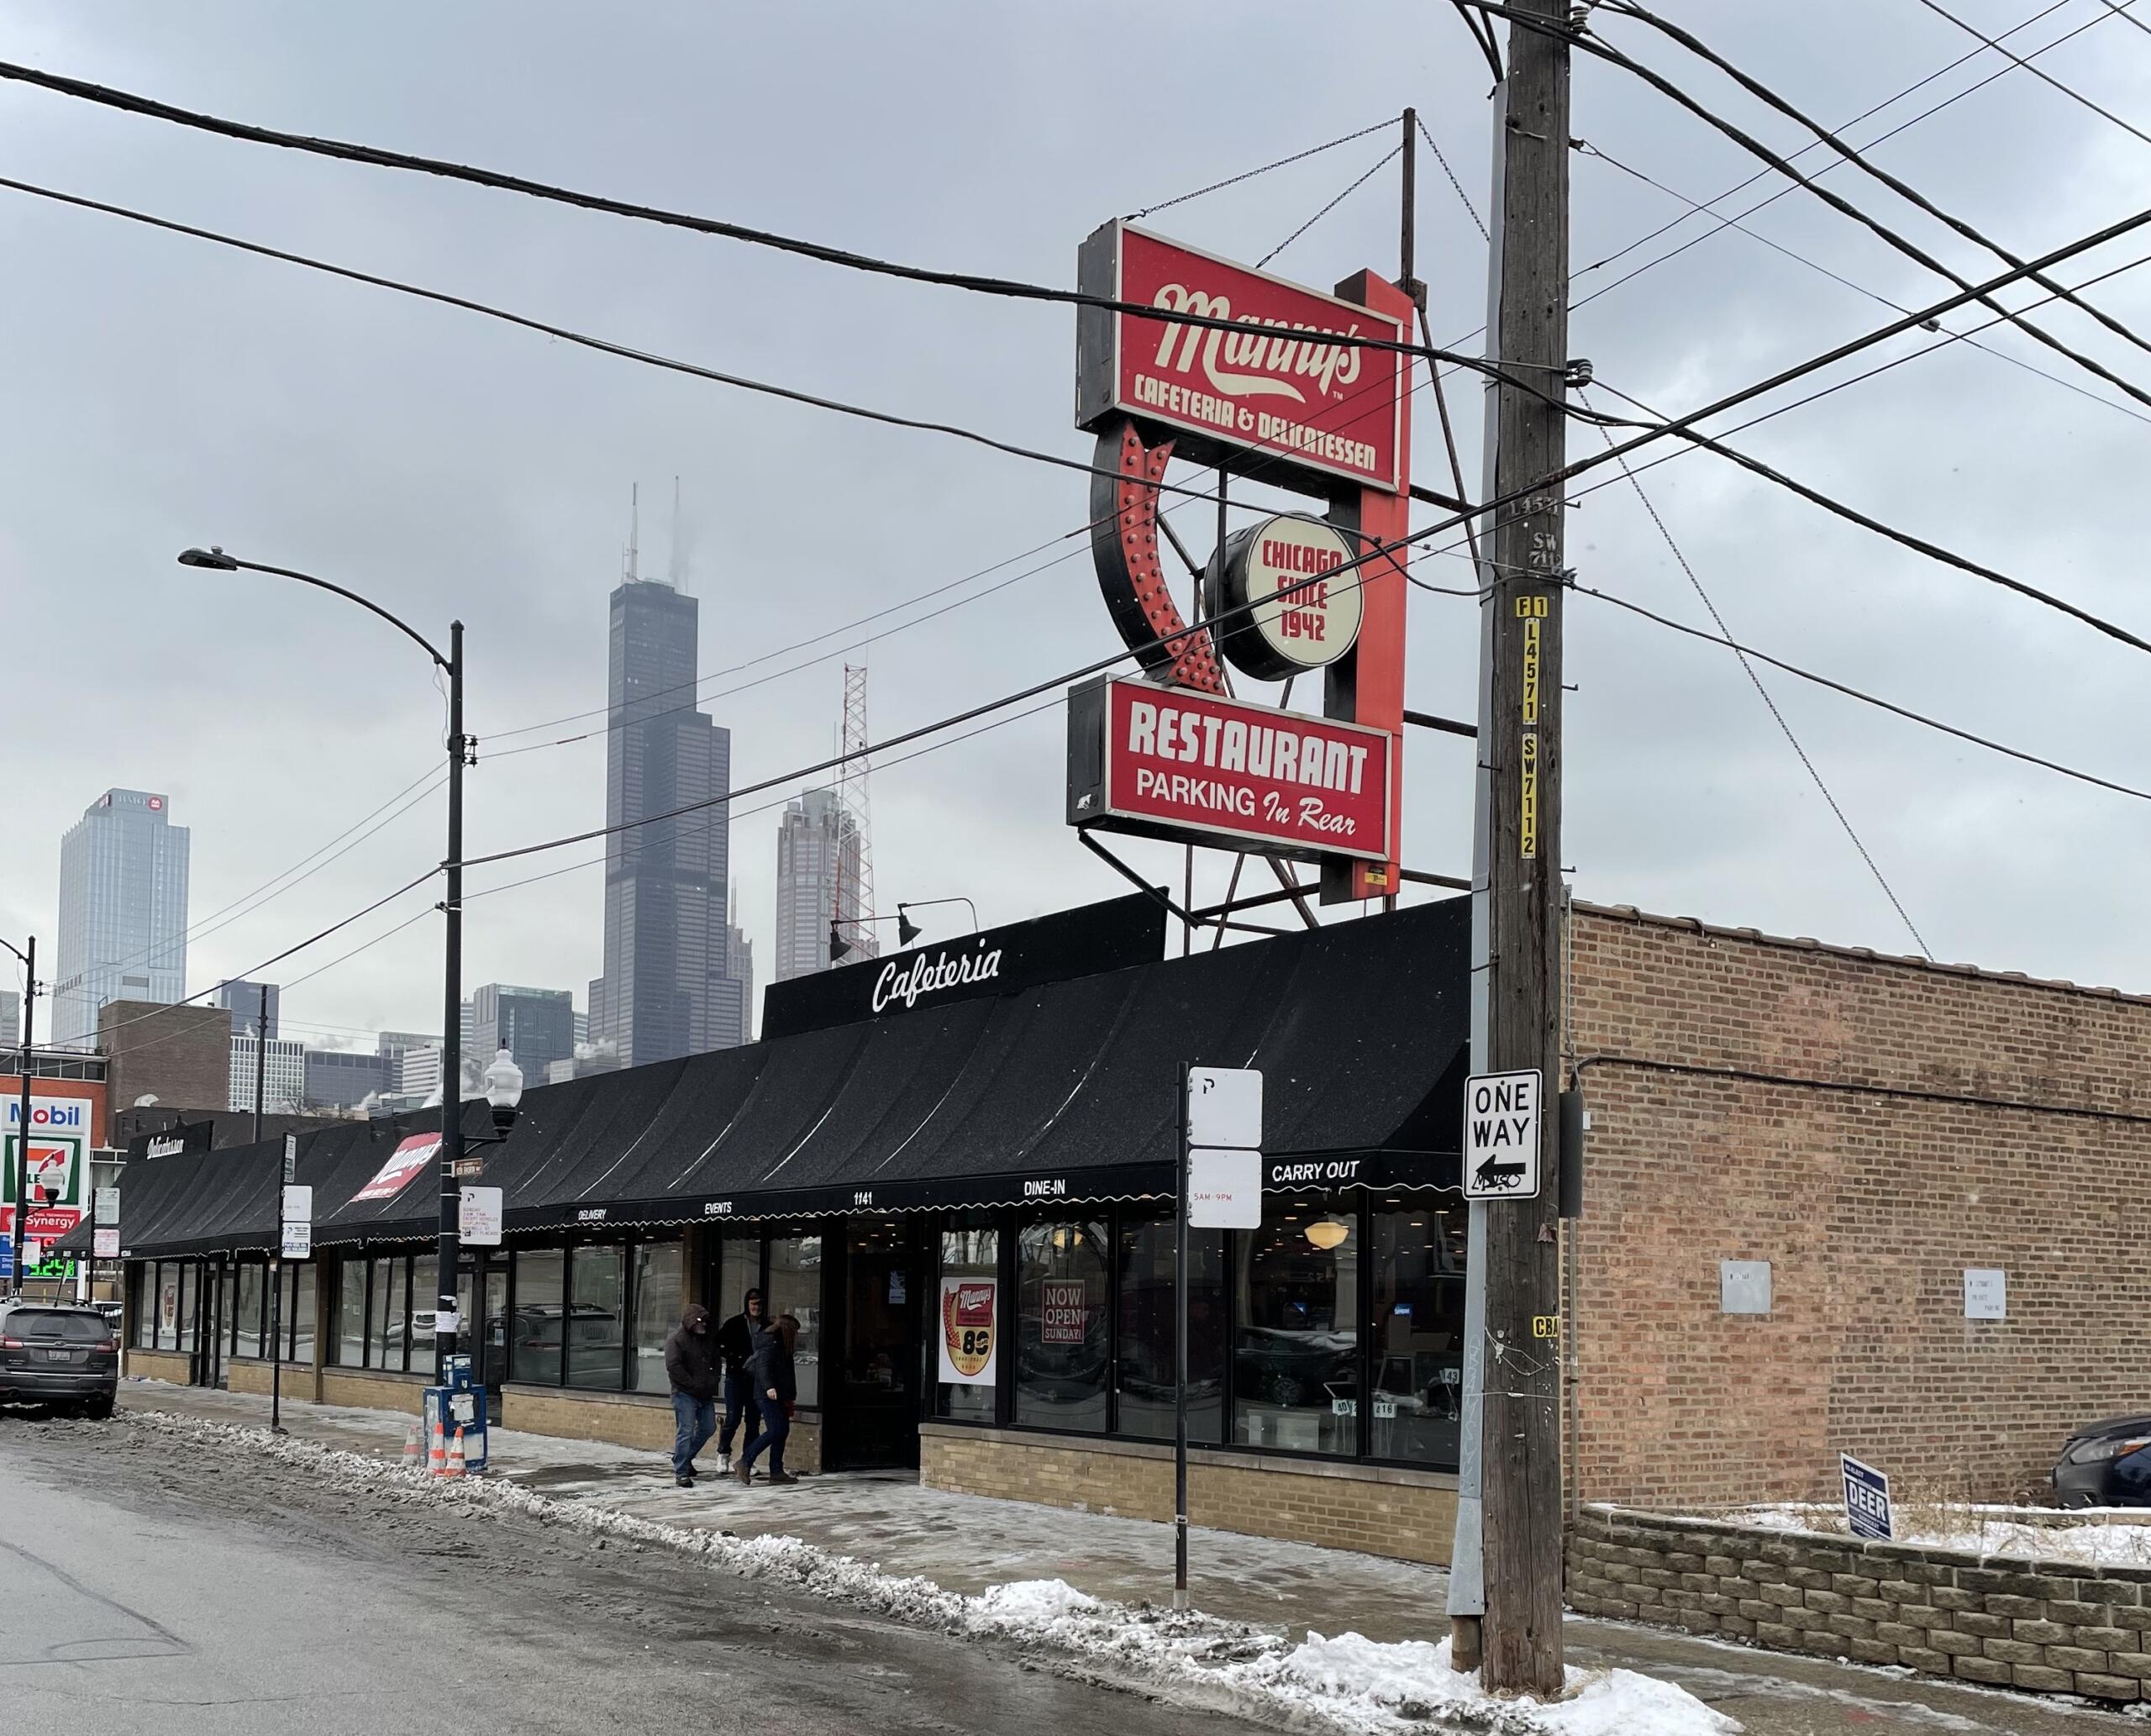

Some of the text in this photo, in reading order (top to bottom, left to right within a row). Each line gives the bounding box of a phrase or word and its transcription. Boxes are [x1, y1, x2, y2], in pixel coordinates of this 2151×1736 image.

[1154, 283, 1367, 404] Manny's
[1134, 374, 1376, 471] CAFETERIA & DELICATESSEN
[1263, 539, 1343, 577] CHICAGO
[1277, 575, 1328, 609] SINCE
[1281, 609, 1325, 642] 1942
[1128, 701, 1368, 795] RESTAURANT
[1136, 768, 1356, 835] PARKING In Rear
[872, 938, 1002, 1013] Cafeteria
[10, 1102, 79, 1126] Mobil
[1475, 1083, 1529, 1114] ONE
[1473, 1117, 1531, 1148] WAY
[1024, 1179, 1066, 1196] DINE-IN
[1272, 1161, 1361, 1183] CARRY OUT
[578, 1208, 607, 1220] DELIVERY
[704, 1202, 732, 1214] EVENTS
[854, 1192, 872, 1206] 1141
[26, 1215, 76, 1229] Synergy
[960, 1286, 991, 1311] Manny's
[1045, 1288, 1081, 1307] NOW
[1045, 1309, 1081, 1326] OPEN
[1849, 1481, 1887, 1522] DEER
